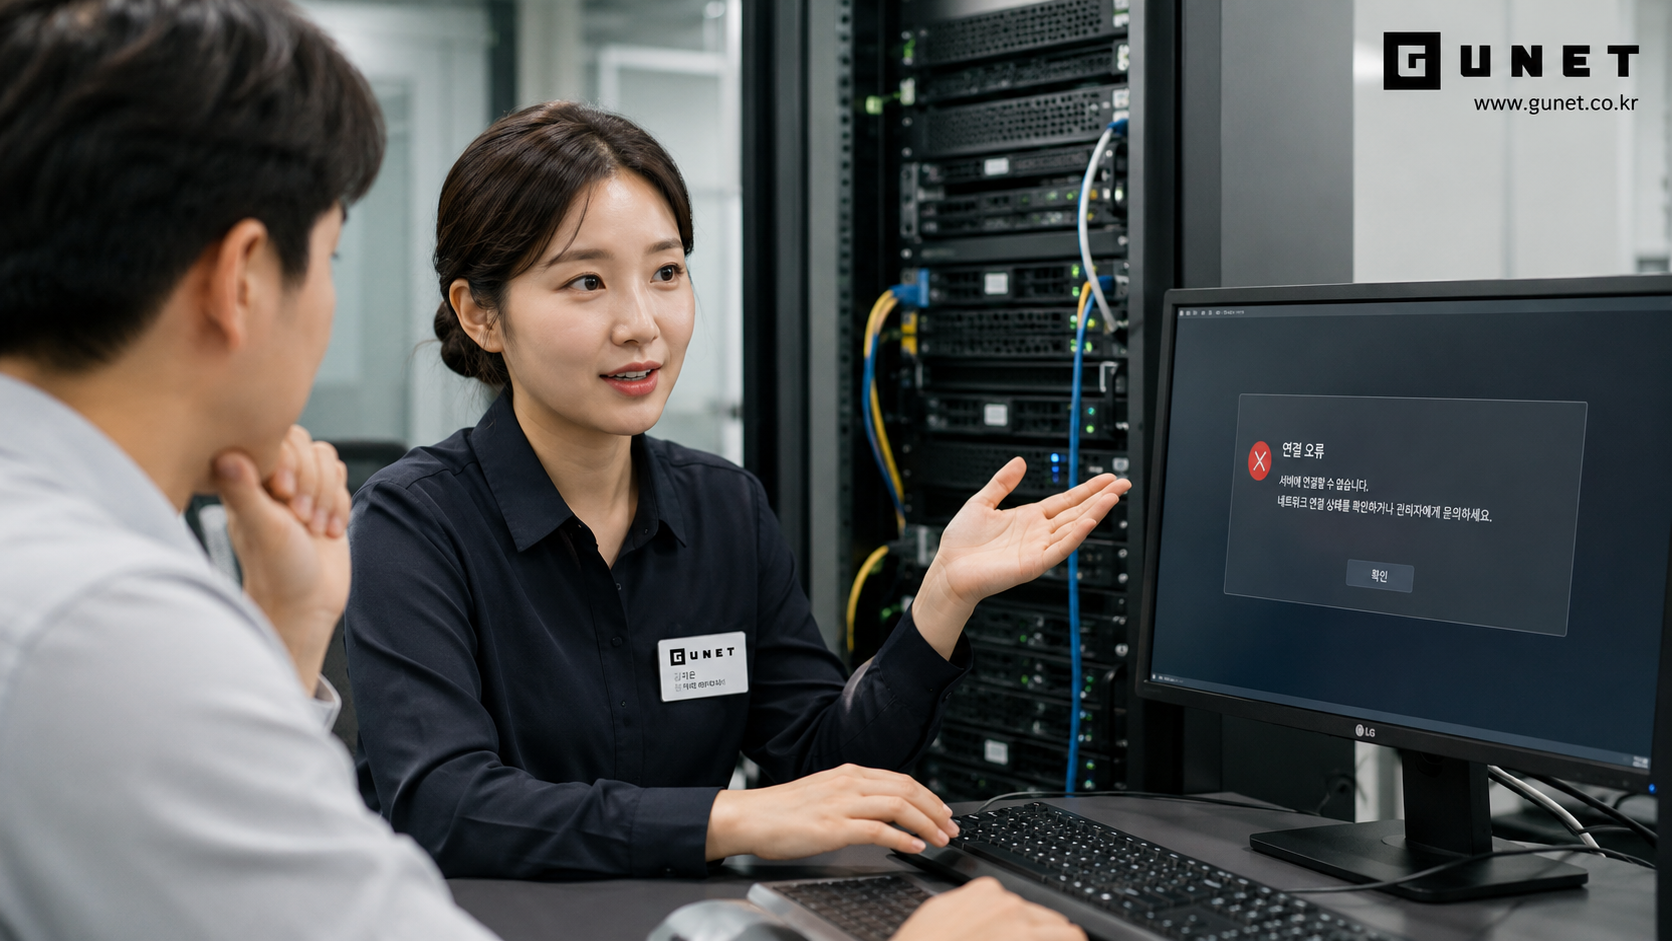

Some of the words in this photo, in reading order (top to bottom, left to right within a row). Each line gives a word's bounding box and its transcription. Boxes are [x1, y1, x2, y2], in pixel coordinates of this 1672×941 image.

[1283, 442, 1302, 458] 연결
[1304, 443, 1324, 459] 오류
[1327, 478, 1334, 490] 수
[1309, 497, 1324, 511] 연결
[1371, 568, 1388, 583] 확인
[669, 647, 735, 666] GUNET
